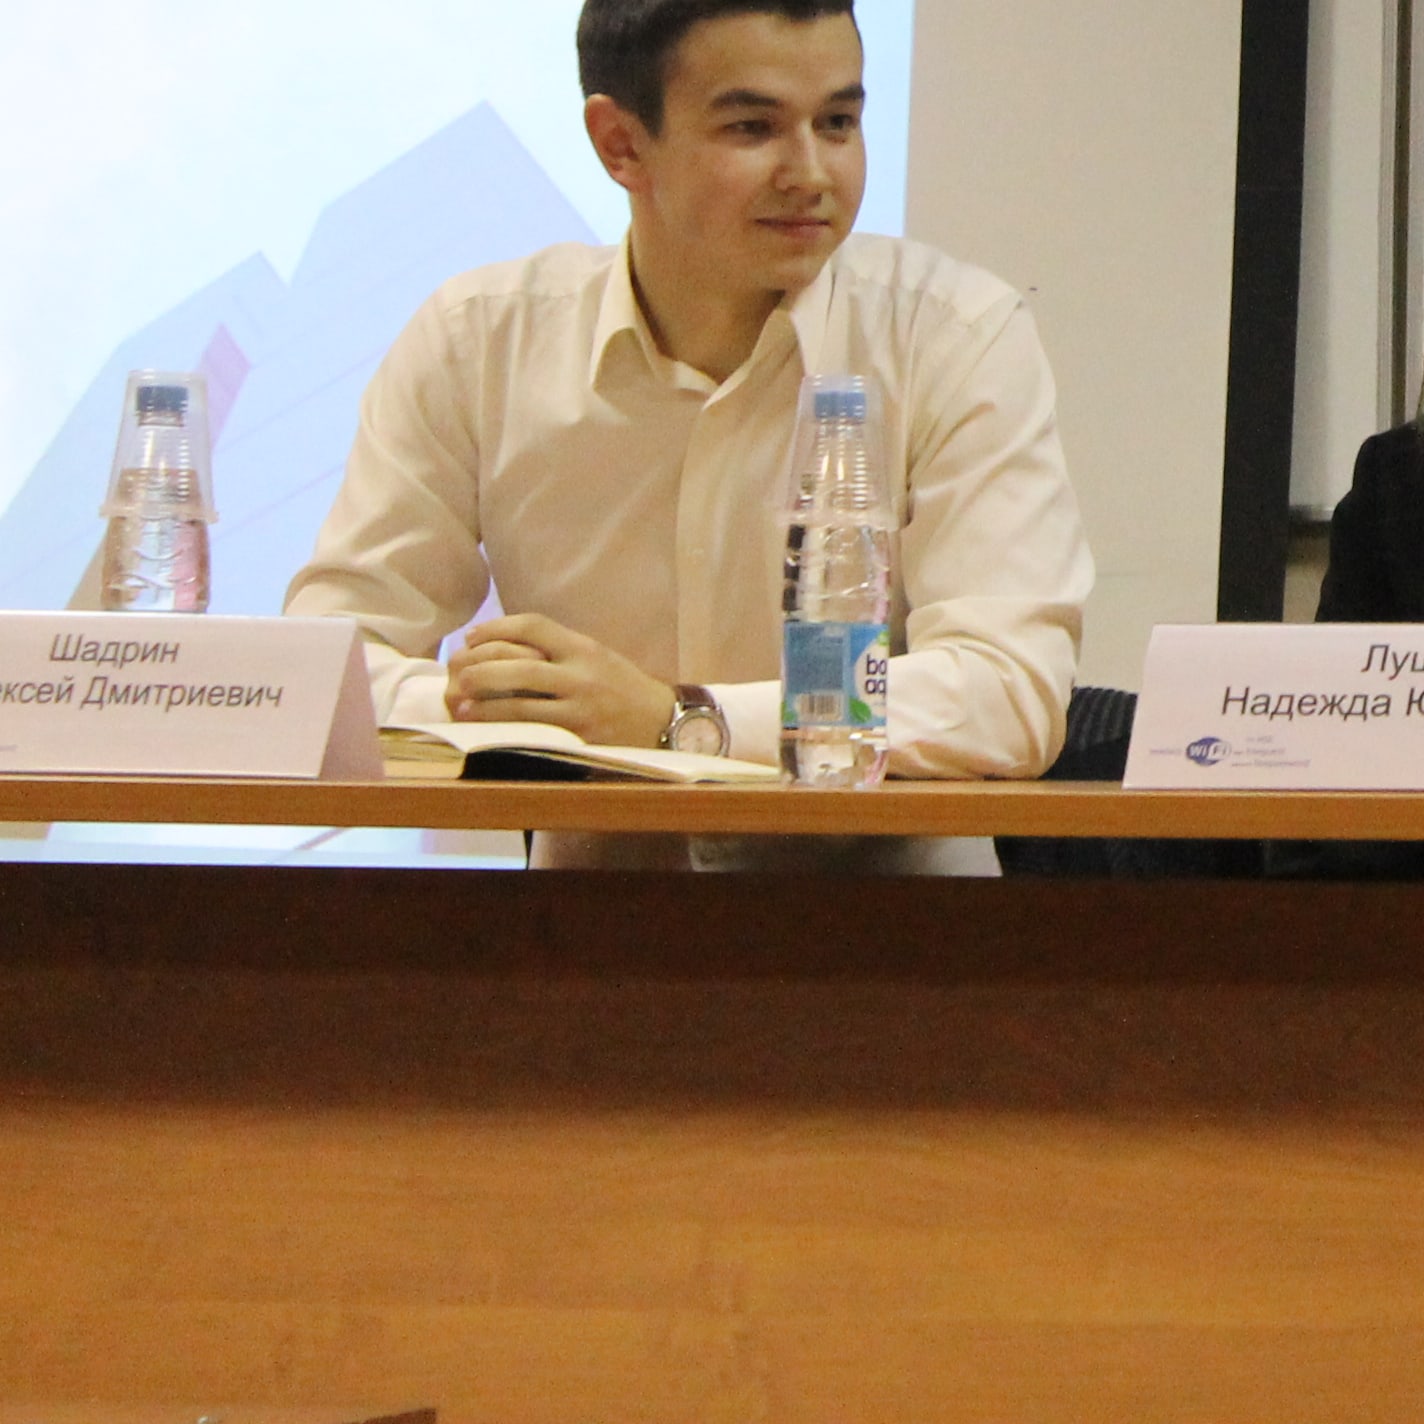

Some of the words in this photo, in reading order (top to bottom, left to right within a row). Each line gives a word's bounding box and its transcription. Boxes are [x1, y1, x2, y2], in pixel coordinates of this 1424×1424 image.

[50, 634, 180, 668] Шадрин
[0, 675, 75, 704] ксей
[80, 676, 283, 712] Дмитриевич
[1222, 687, 1391, 718] Надежда
